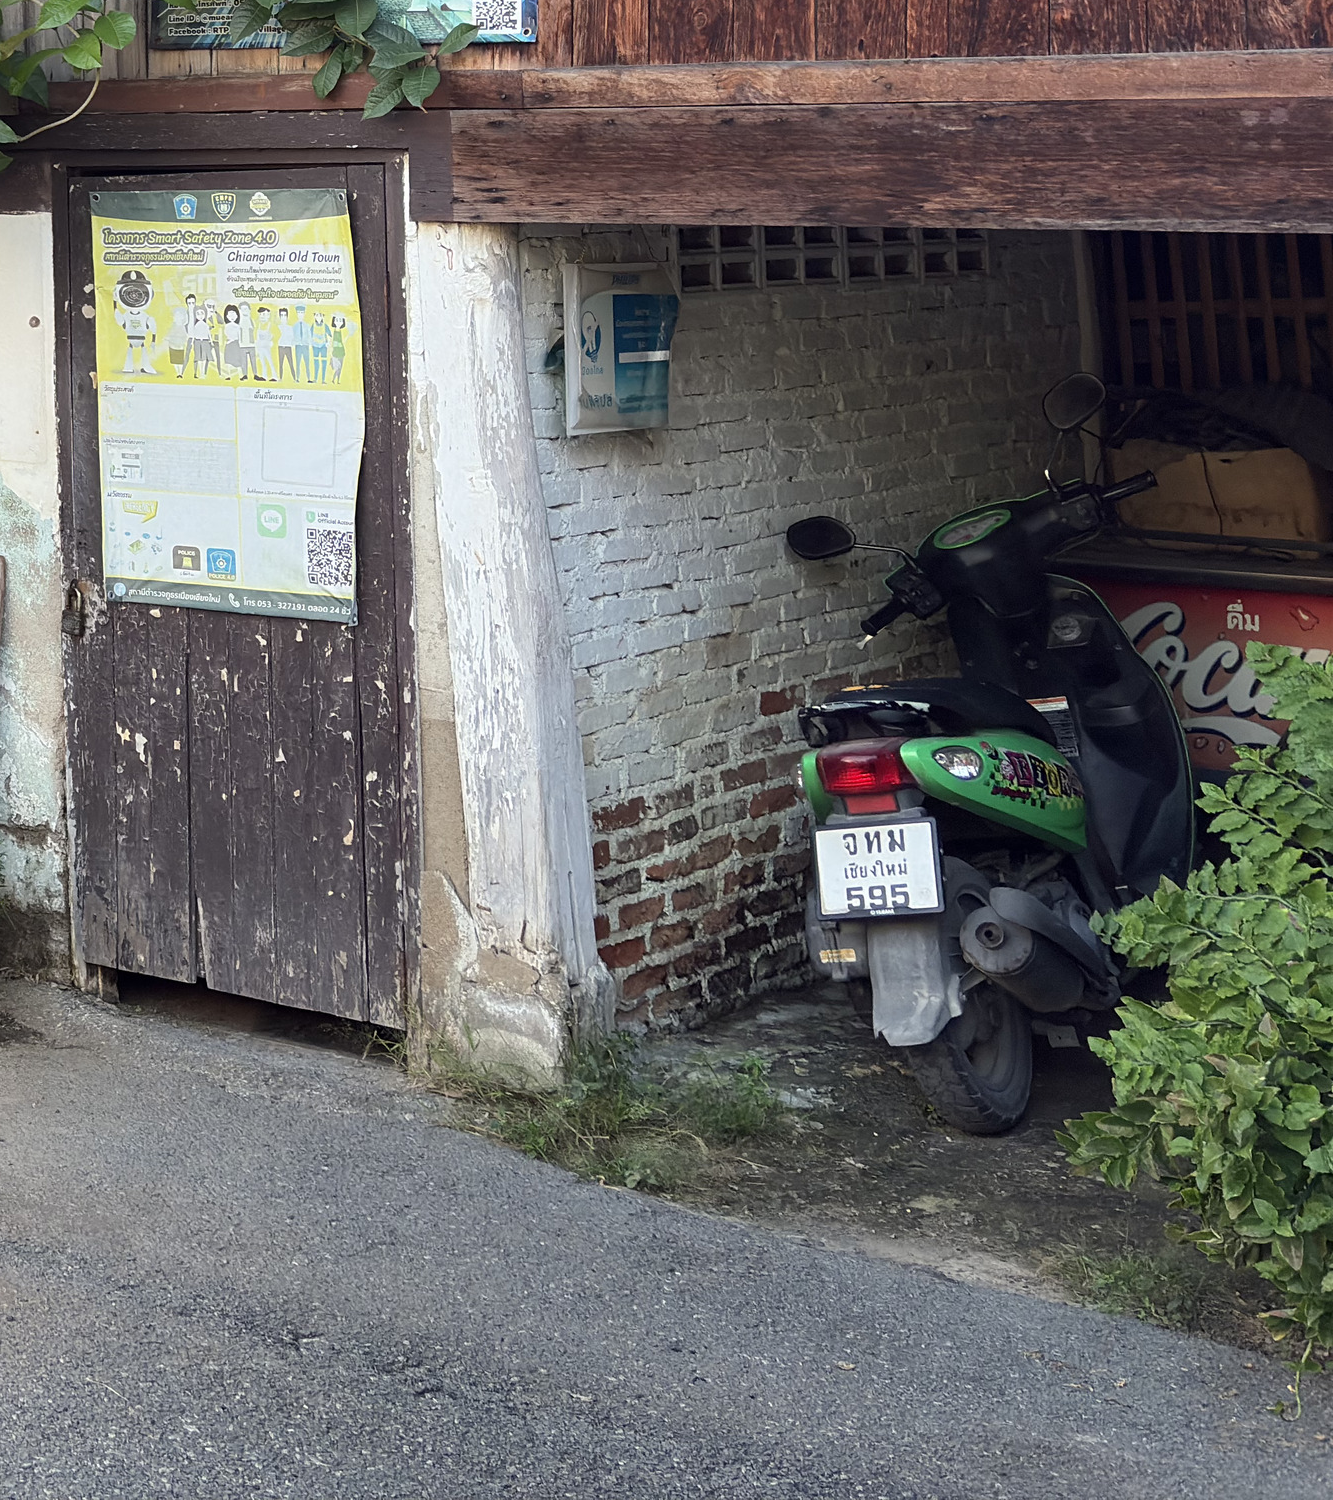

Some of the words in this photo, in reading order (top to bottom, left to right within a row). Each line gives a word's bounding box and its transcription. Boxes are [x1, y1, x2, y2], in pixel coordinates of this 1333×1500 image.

[168, 15, 185, 23] Line
[168, 27, 206, 35] Facebook
[213, 26, 229, 34] RTP
[148, 231, 181, 244] Smart
[184, 232, 222, 248] Safety
[223, 232, 252, 244] Zone
[254, 231, 276, 244] 4.0
[227, 251, 285, 264] Chiangmai
[288, 251, 308, 263] Old
[311, 252, 341, 263] Town
[264, 515, 280, 524] LINE
[243, 596, 256, 608] โทร
[257, 600, 272, 609] 053
[277, 602, 307, 612] 327191
[330, 605, 341, 614] 24
[1226, 599, 1260, 632] ดื่ม
[843, 858, 908, 880] เชียงใหม่
[845, 883, 910, 911] 595
